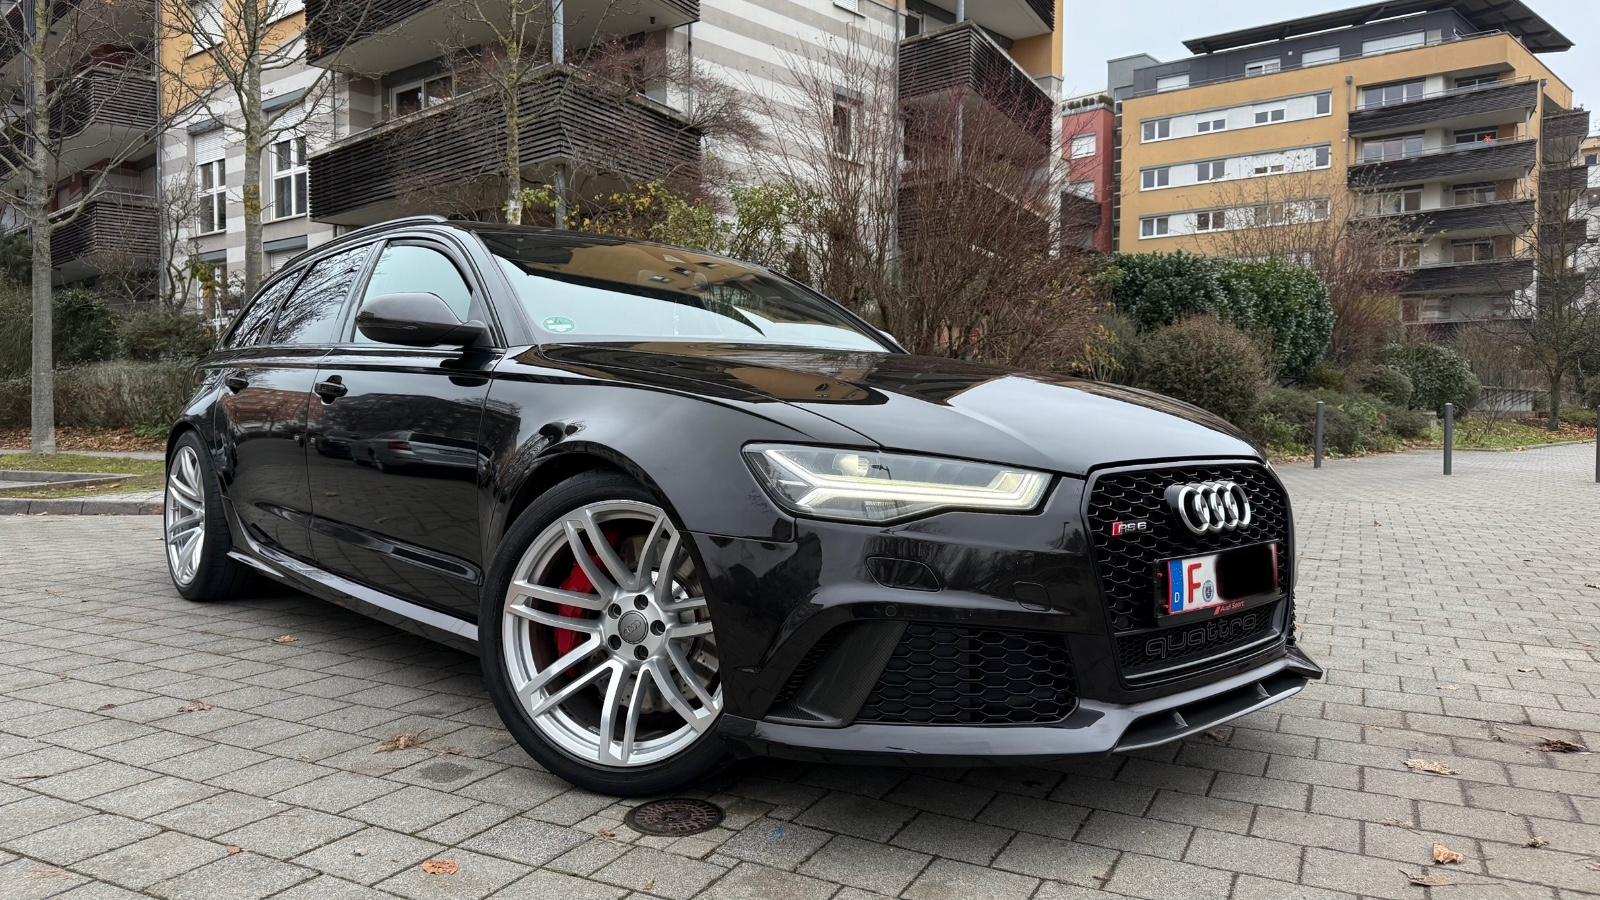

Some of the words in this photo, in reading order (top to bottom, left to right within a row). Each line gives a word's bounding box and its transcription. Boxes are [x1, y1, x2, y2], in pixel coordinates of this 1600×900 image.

[1187, 562, 1202, 604] F
[1174, 592, 1180, 603] D
[1231, 601, 1245, 609] Sport
[1145, 613, 1257, 659] quattro
